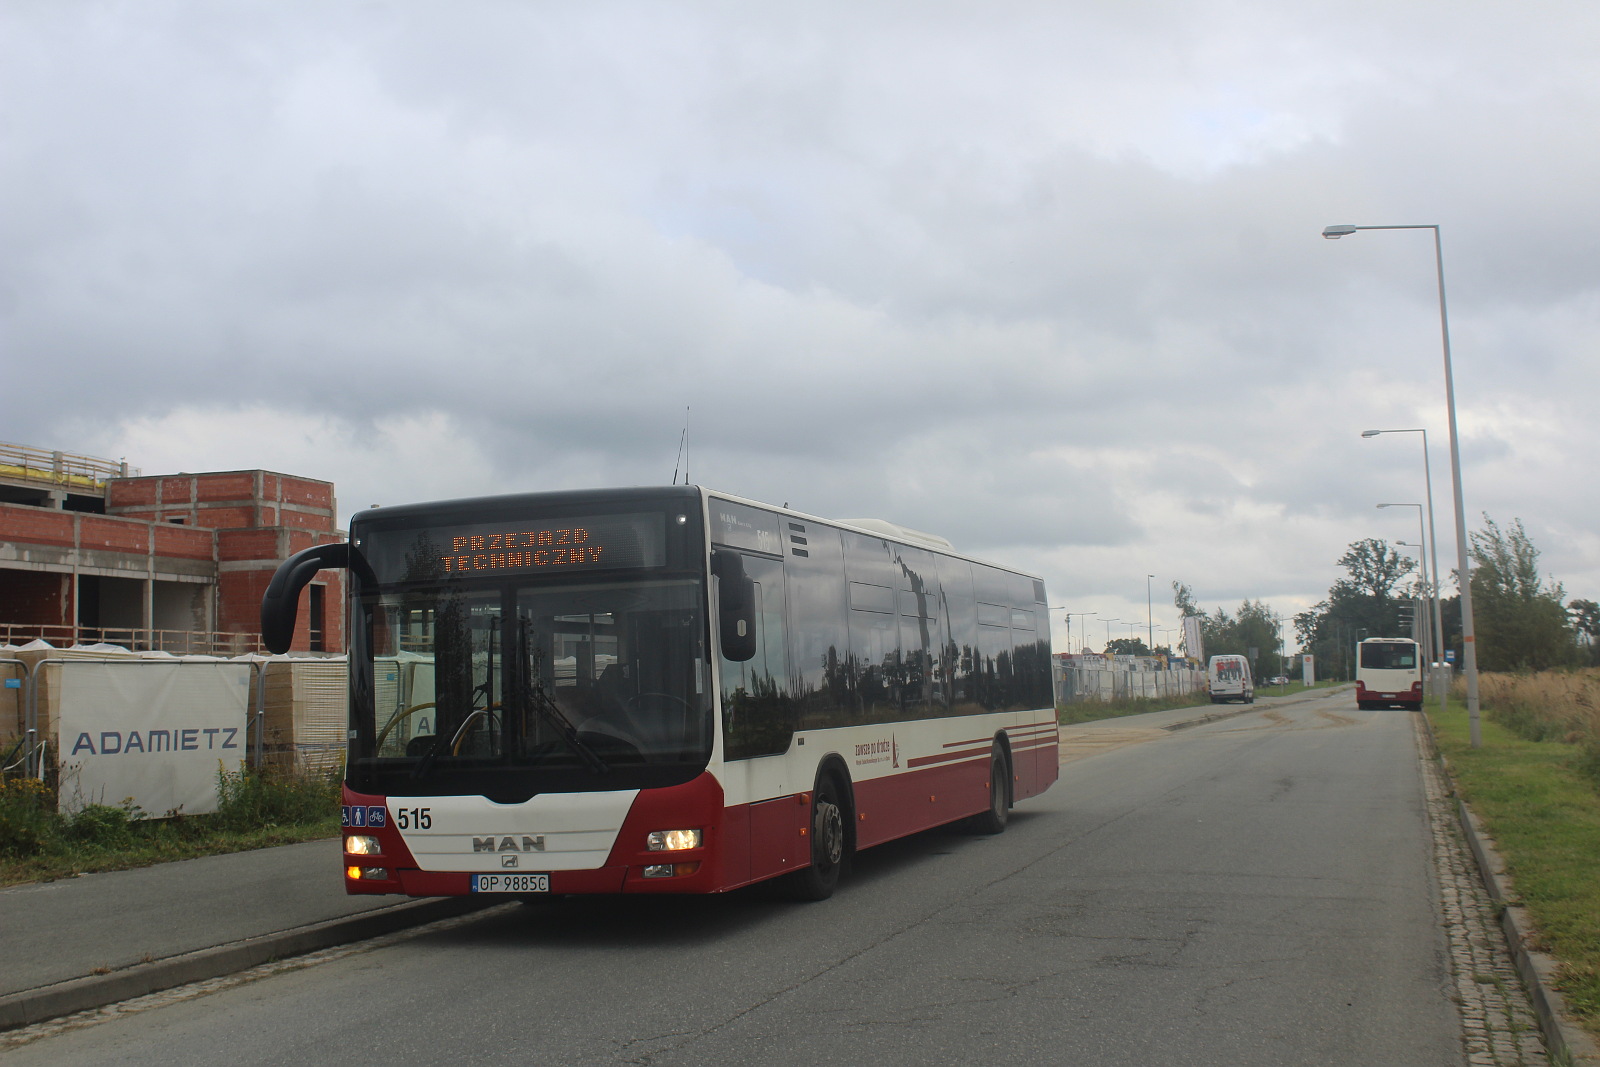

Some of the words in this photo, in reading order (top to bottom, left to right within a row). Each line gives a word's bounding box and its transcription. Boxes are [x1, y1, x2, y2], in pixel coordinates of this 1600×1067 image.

[453, 528, 588, 552] PRZEJAZD
[441, 546, 602, 572] TECHNICZNY
[71, 728, 238, 755] ADAMIETZ
[398, 808, 432, 829] 515
[472, 835, 545, 852] MAN
[480, 876, 499, 891] OP
[504, 876, 547, 891] 9885C
